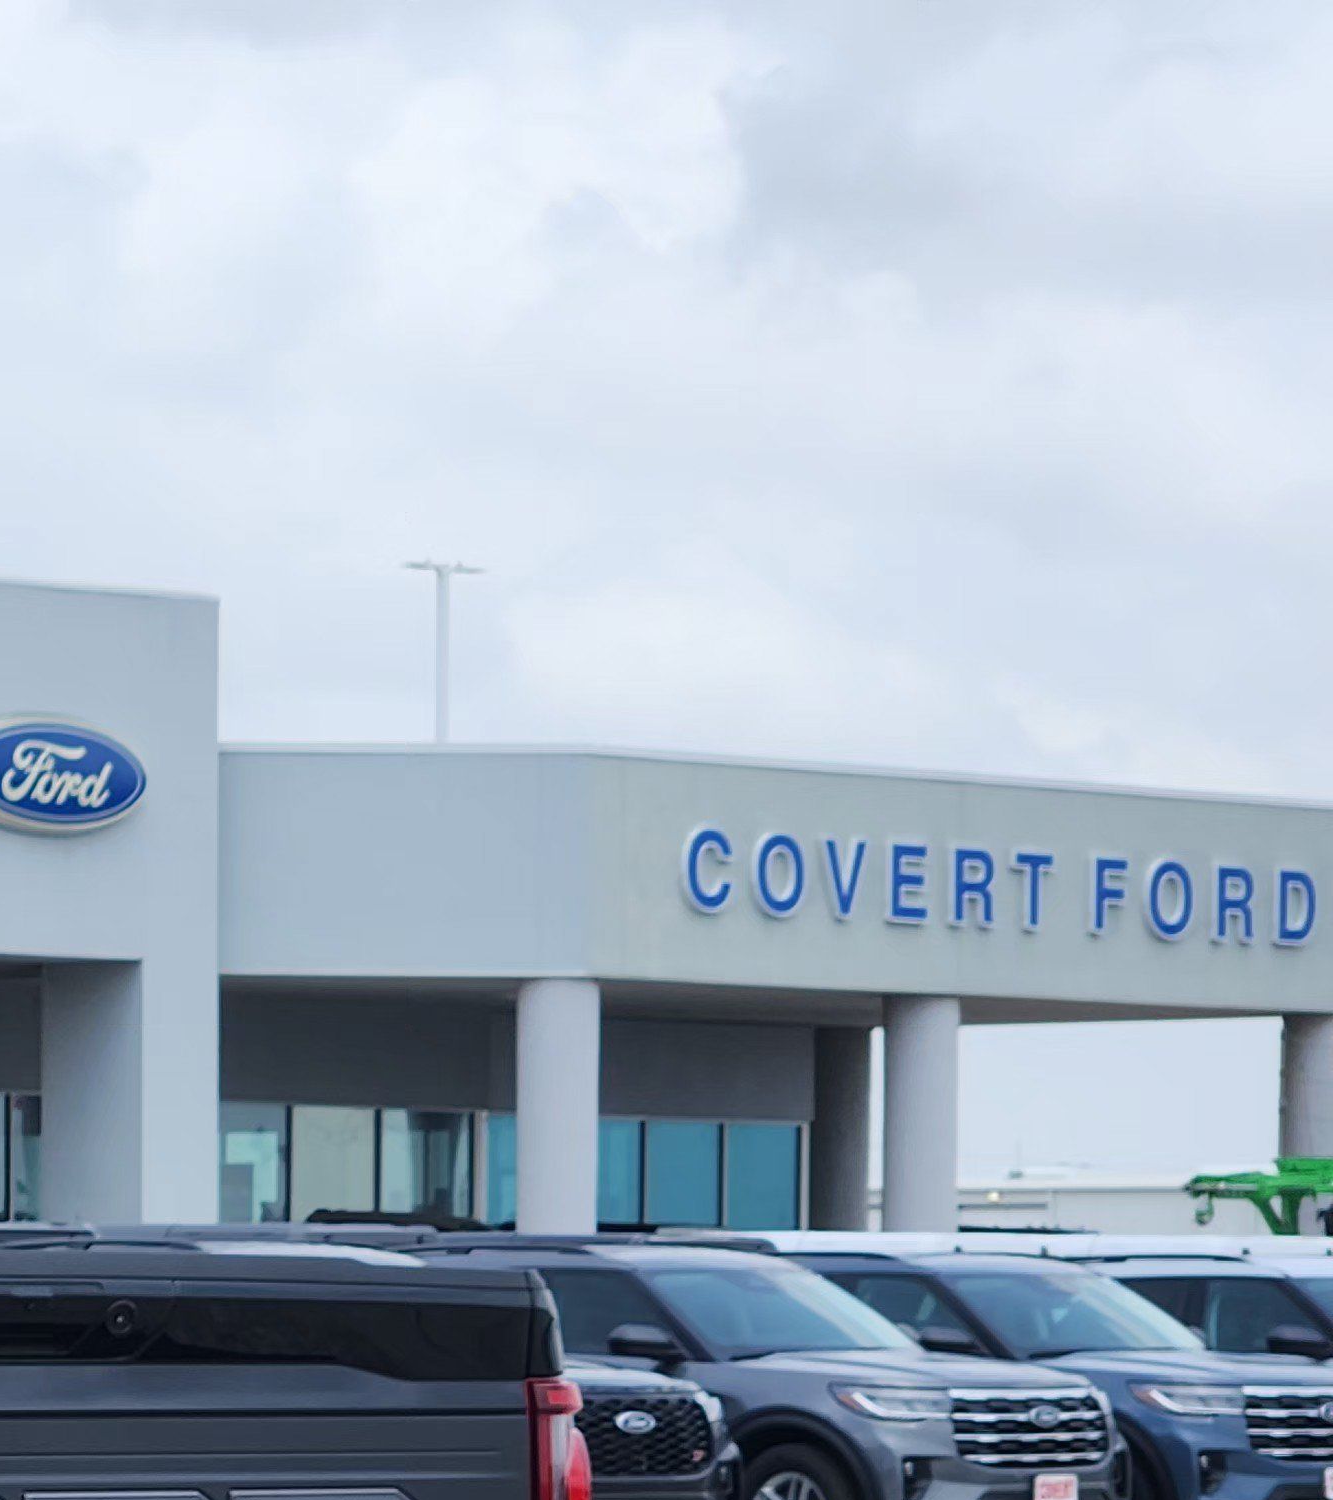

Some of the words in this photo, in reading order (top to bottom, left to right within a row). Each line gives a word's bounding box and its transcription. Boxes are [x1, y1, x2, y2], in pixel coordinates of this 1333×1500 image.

[1, 739, 114, 808] Ford
[686, 828, 1055, 927] COVERT
[1092, 856, 1317, 942] FORD
